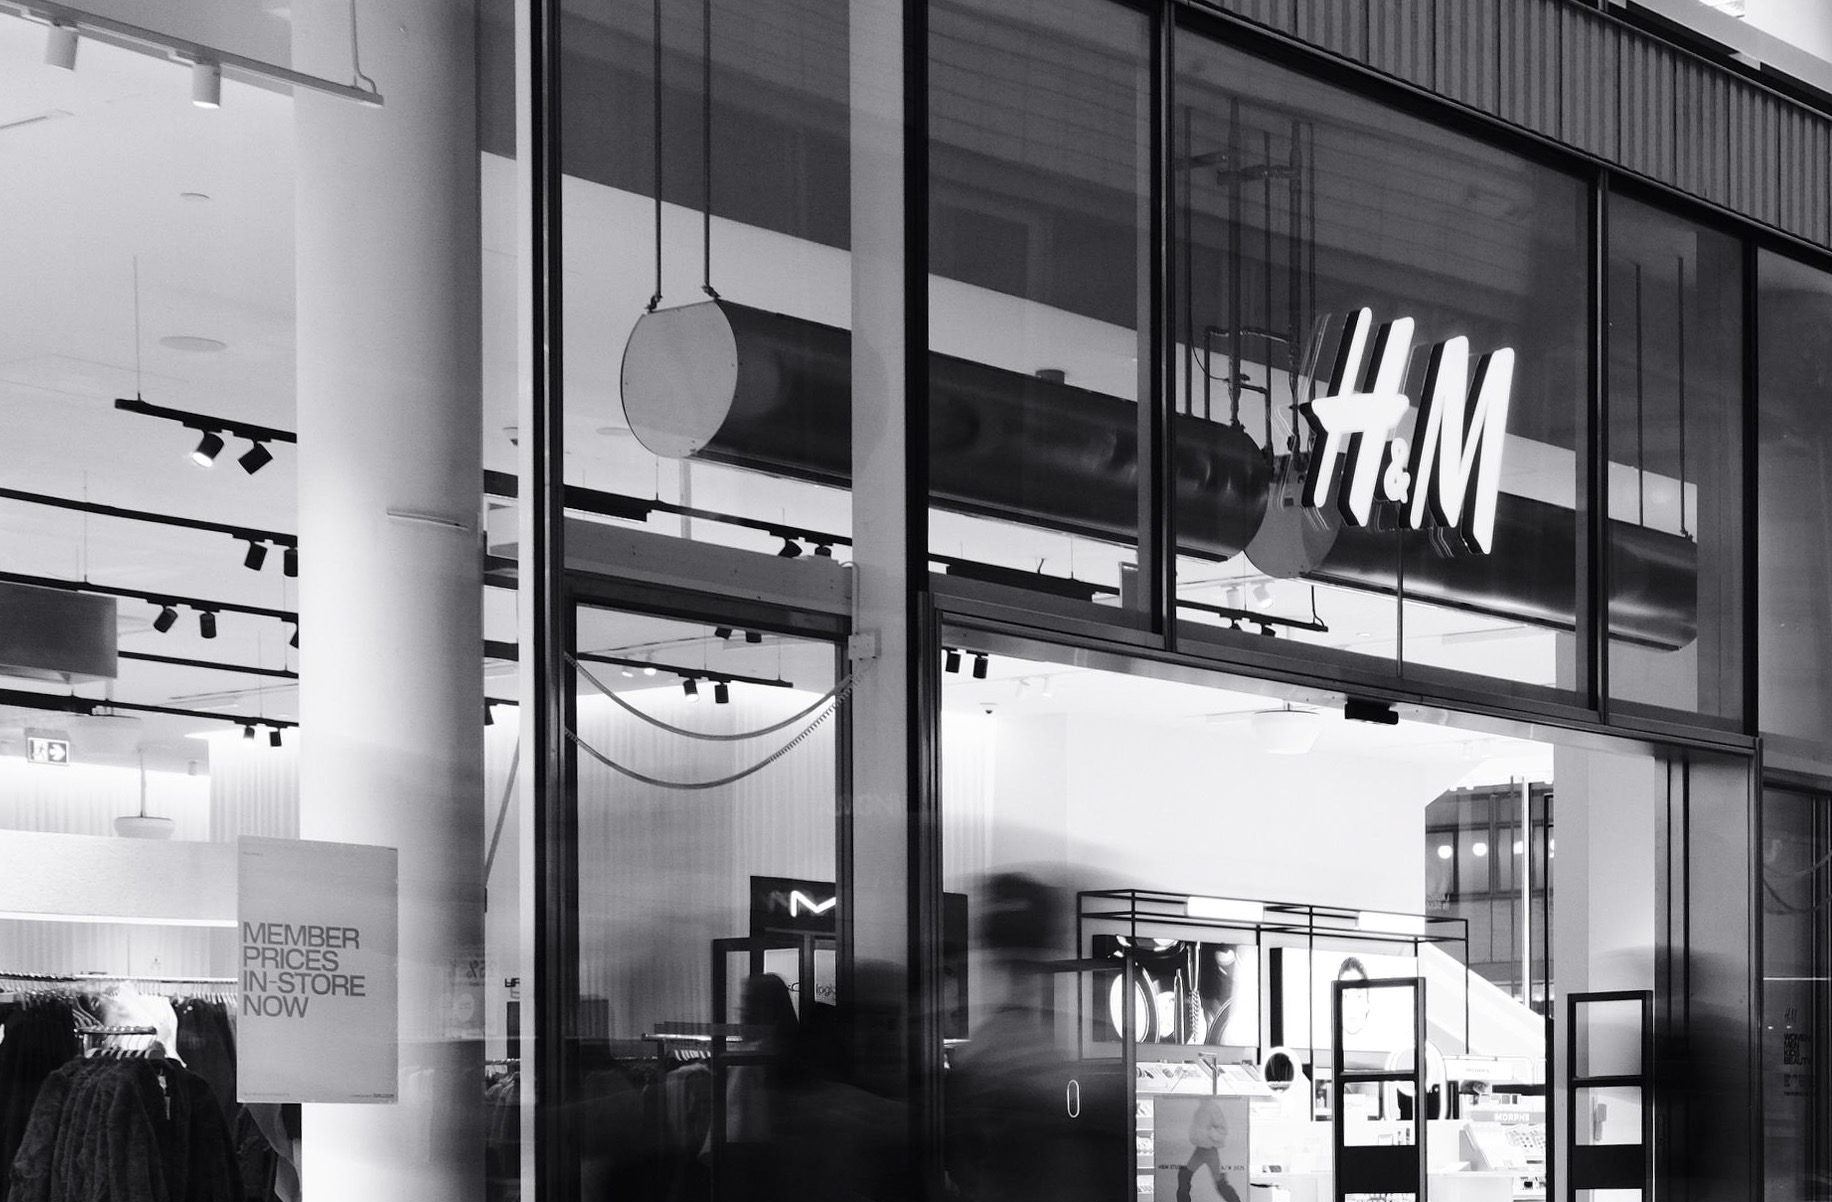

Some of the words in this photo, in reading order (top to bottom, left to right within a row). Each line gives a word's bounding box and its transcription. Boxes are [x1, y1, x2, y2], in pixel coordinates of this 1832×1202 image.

[1309, 306, 1516, 556] H&M
[243, 922, 360, 950] MEMBER
[243, 946, 339, 972] PRICES
[243, 970, 366, 997] IN-STORE
[243, 994, 309, 1018] NOW
